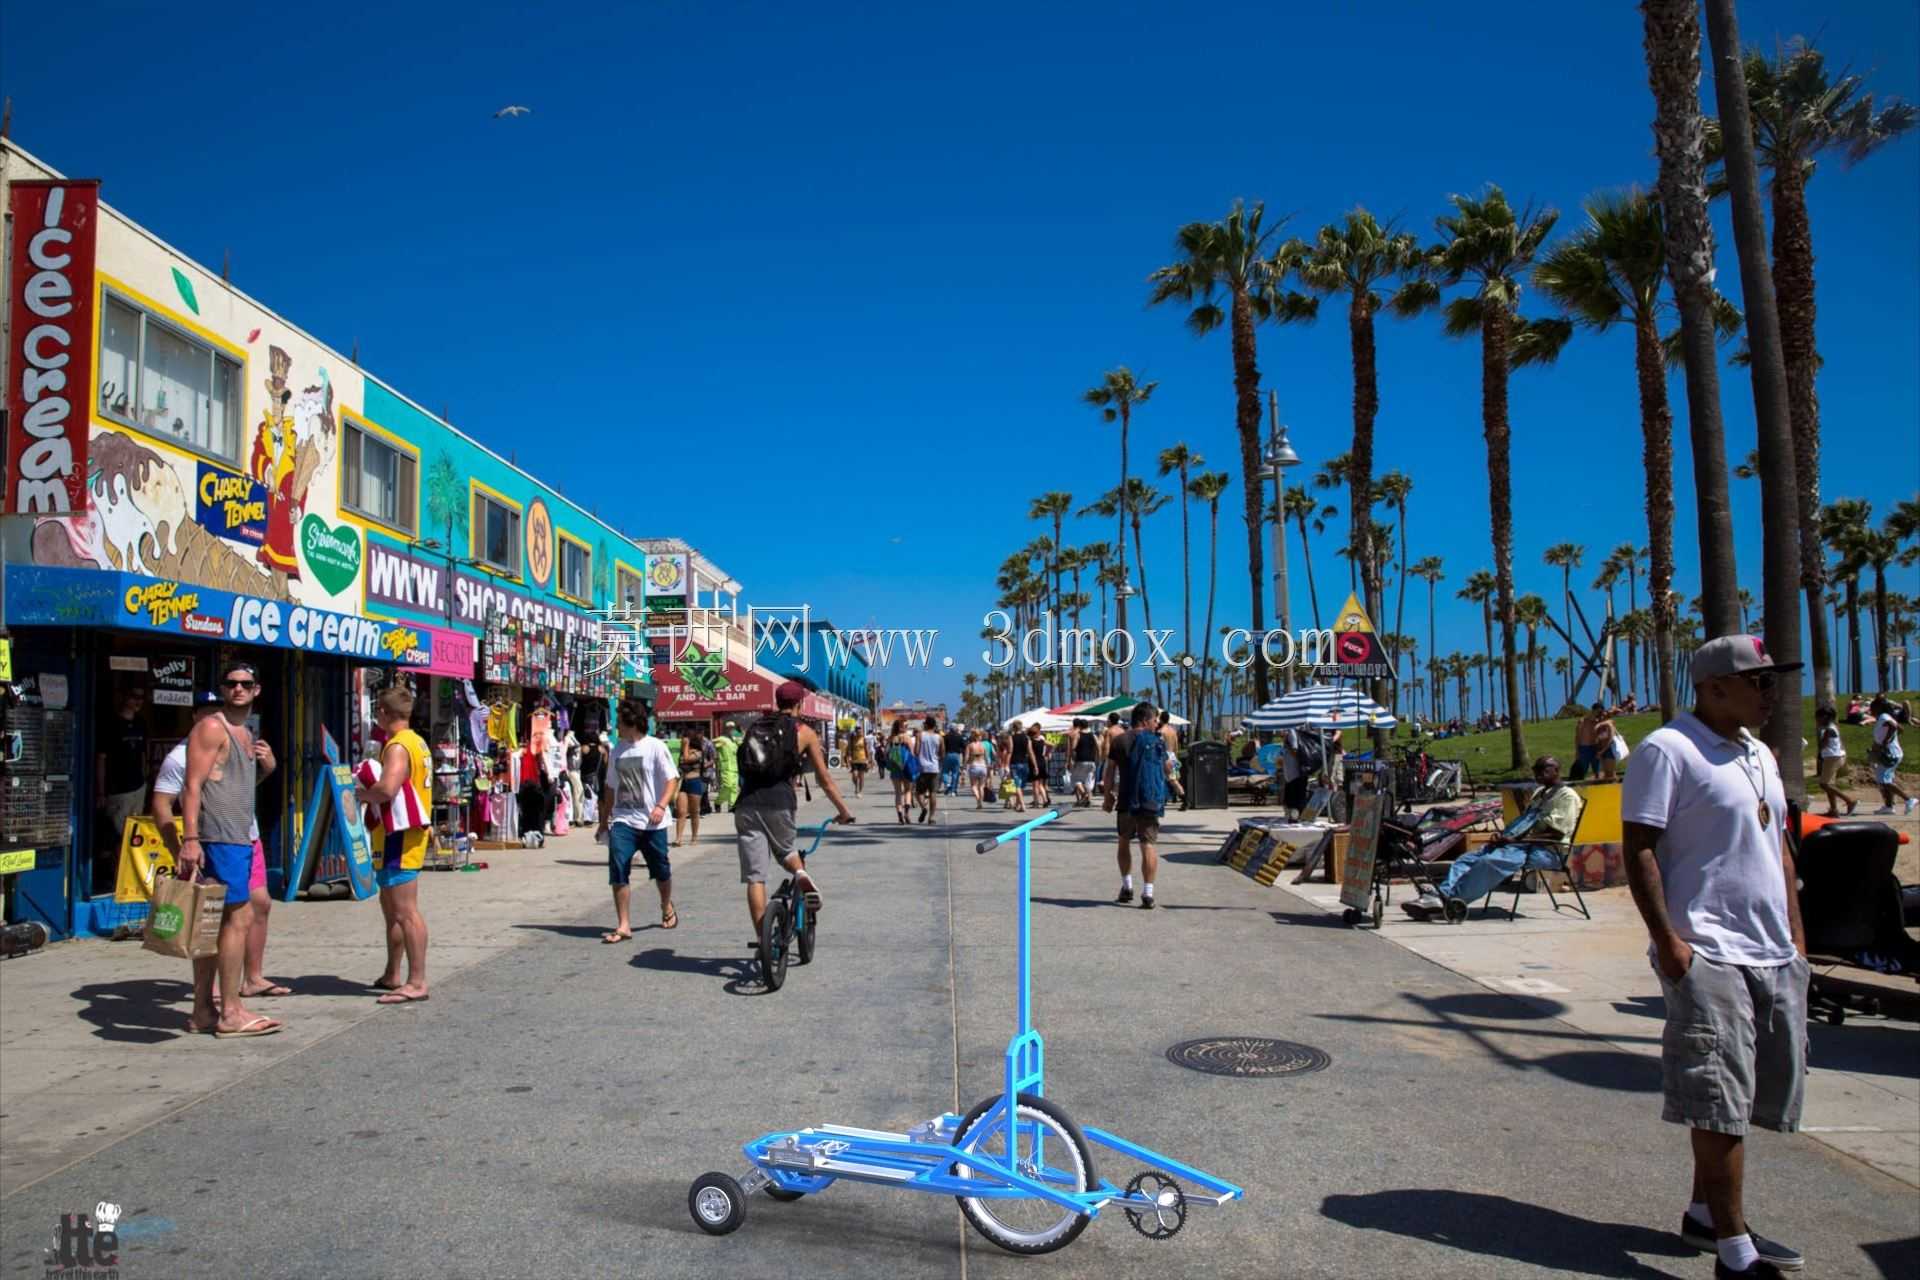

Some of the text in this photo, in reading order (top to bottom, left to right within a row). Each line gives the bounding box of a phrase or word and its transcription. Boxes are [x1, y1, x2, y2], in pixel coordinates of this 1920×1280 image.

[25, 187, 73, 318] Ice
[371, 549, 444, 611] WWW.
[125, 582, 178, 613] CHARLY
[229, 596, 281, 643] Ice
[288, 607, 381, 657] cream
[153, 660, 186, 678] belly
[160, 676, 192, 687] rings
[662, 685, 680, 693] THE
[735, 684, 759, 692] CAFE
[676, 693, 696, 701] AND
[726, 693, 746, 701] BAR
